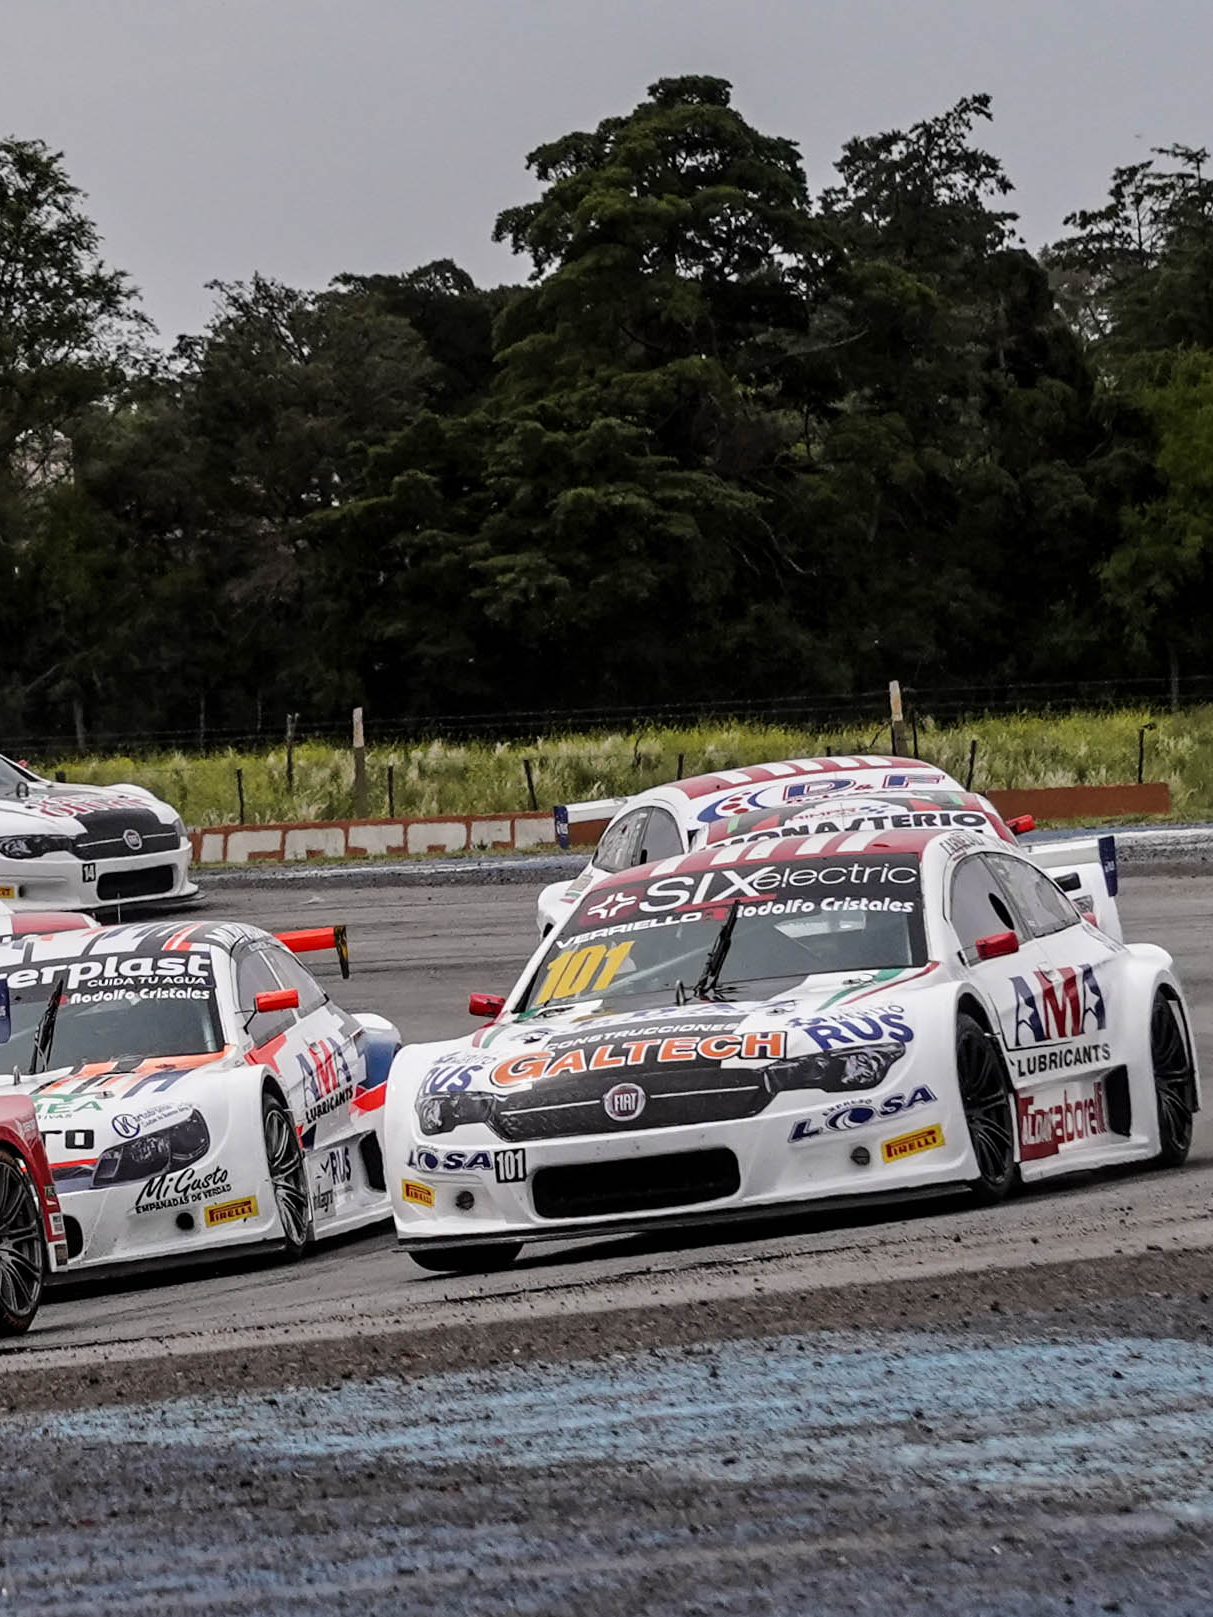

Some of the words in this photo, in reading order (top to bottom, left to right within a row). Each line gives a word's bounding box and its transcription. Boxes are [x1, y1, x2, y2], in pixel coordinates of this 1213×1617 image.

[819, 897, 914, 914] Cristales
[556, 912, 700, 949] VERRIELLO
[88, 977, 134, 987] CUIDA
[138, 977, 158, 986] TU
[164, 976, 206, 986] AGUA
[536, 941, 635, 1004] 101
[71, 990, 133, 1004] Rodolfo
[136, 987, 209, 1001] Cristales
[1008, 964, 1107, 1046] AMA
[803, 1014, 914, 1052] RUS
[490, 1032, 787, 1087] GALTECH
[1017, 1043, 1111, 1078] LUBRICANTS
[306, 1086, 353, 1123] LUBRICANTS
[613, 1089, 637, 1114] FIAT
[887, 1130, 937, 1157] PIRELLI
[497, 1151, 525, 1181] 101
[136, 1174, 174, 1206] Mi
[175, 1166, 229, 1196] Gusto
[136, 1198, 189, 1215] EMPANADAS
[209, 1200, 252, 1222] PIRELLI
